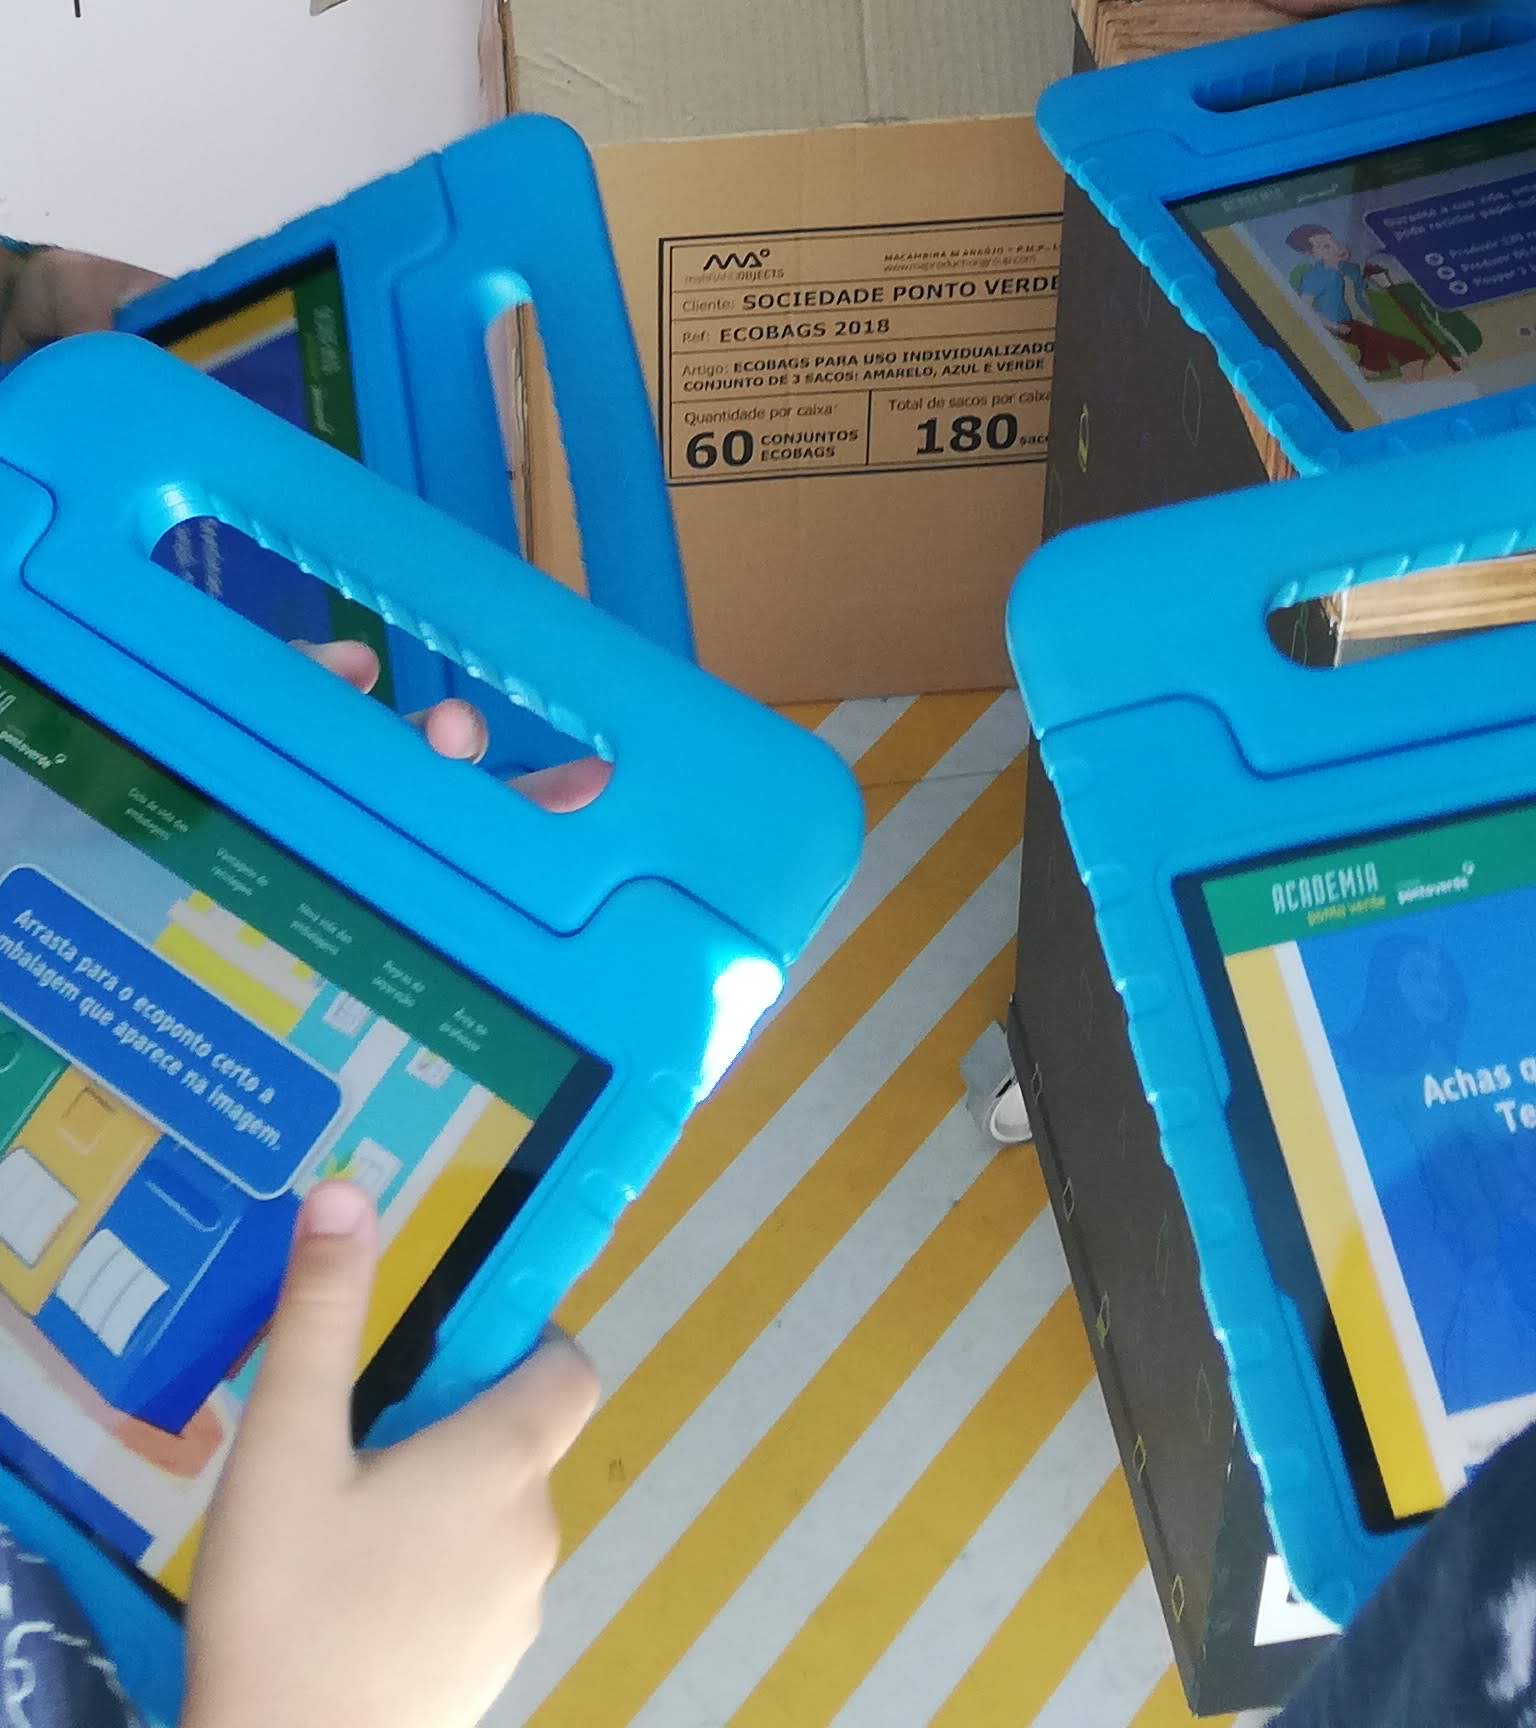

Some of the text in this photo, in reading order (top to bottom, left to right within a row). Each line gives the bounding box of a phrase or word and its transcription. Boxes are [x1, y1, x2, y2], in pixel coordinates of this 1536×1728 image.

[743, 287, 884, 310] SOCIEDADE
[893, 280, 976, 302] PONTO
[719, 323, 827, 344] ECOBAGS
[834, 318, 890, 337] 2018
[684, 375, 764, 393] CONJUNTO
[768, 373, 789, 387] DE
[792, 372, 801, 385] 3
[864, 365, 937, 381] AMARELO,
[942, 362, 979, 376] AZUL
[984, 361, 992, 373] E
[997, 357, 1045, 372] VERDE
[733, 356, 810, 373] ECOBAGS
[815, 354, 859, 367] PARA
[864, 352, 896, 365] USO
[684, 406, 765, 426] Quantidade
[769, 404, 792, 422] por
[888, 396, 923, 412] Total
[929, 396, 945, 410] de
[949, 394, 988, 409] sacos
[992, 392, 1014, 407] por
[685, 430, 859, 470] 60 CONJUNTOS
[916, 413, 1018, 456] 180
[761, 446, 835, 462] ECOBAGS
[1271, 861, 1379, 915] ACADEMIA
[12, 908, 275, 1105] Arrasta para o ecoponto certo a
[78, 996, 115, 1027] que
[111, 1020, 184, 1076] aparece
[180, 1069, 209, 1096] na
[1423, 1063, 1512, 1109] Achas
